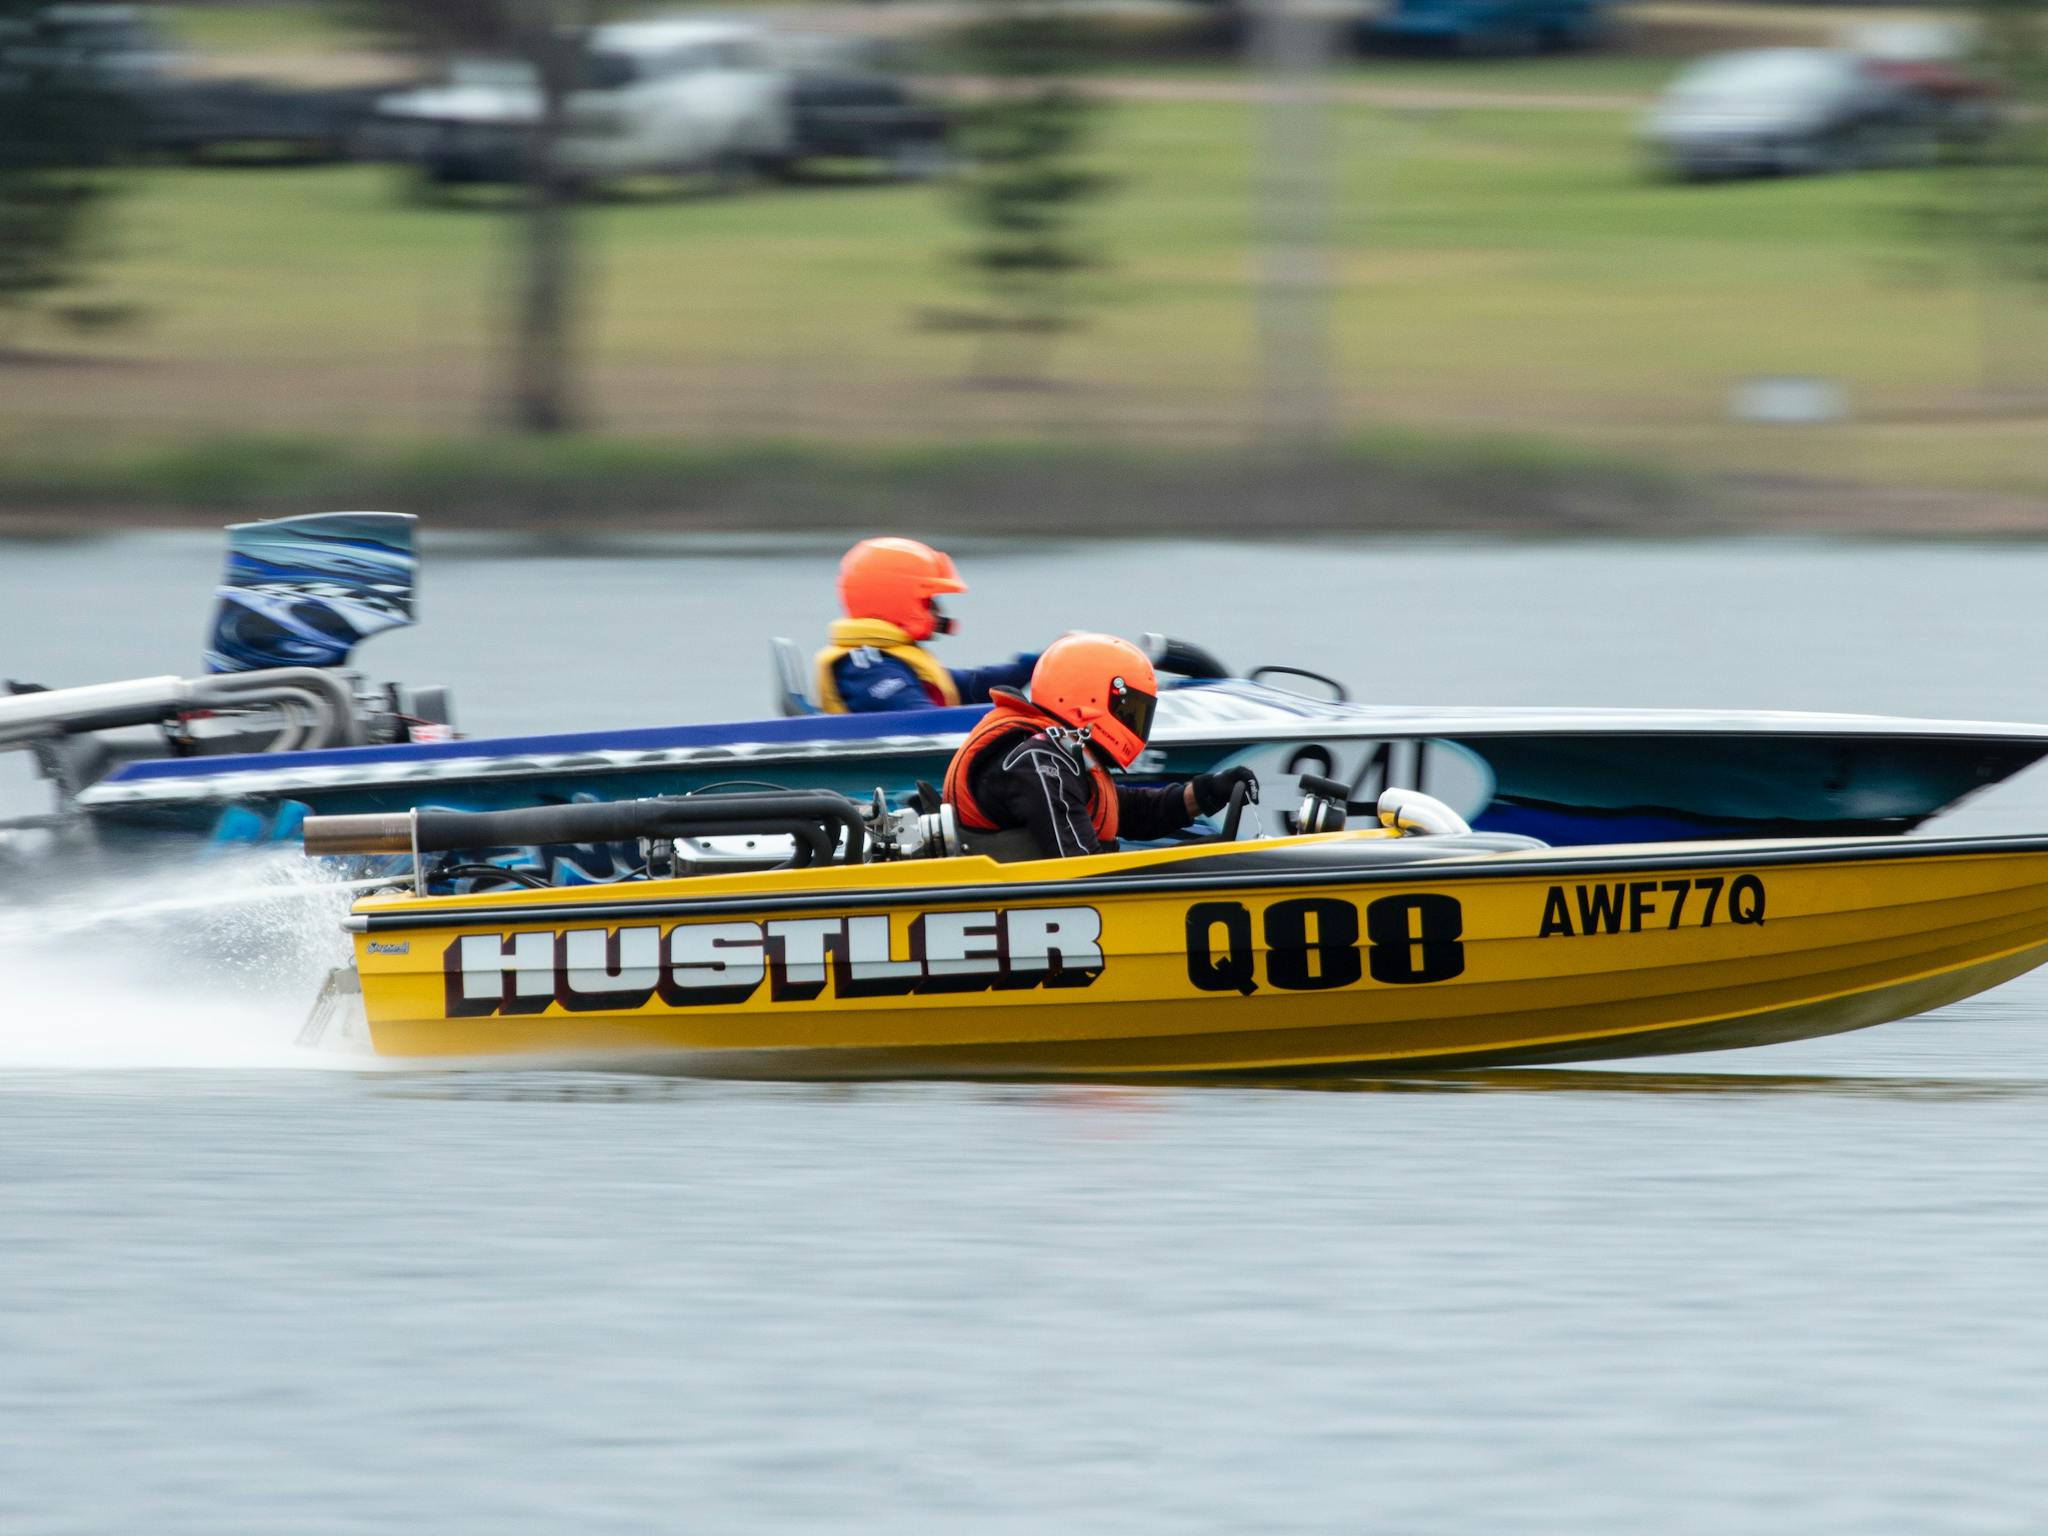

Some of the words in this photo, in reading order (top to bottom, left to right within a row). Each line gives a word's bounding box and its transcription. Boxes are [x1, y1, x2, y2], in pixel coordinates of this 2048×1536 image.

[1185, 893, 1466, 997] Q88
[1538, 874, 1767, 939] AWF77Q
[444, 906, 1105, 1017] HUSTLER
